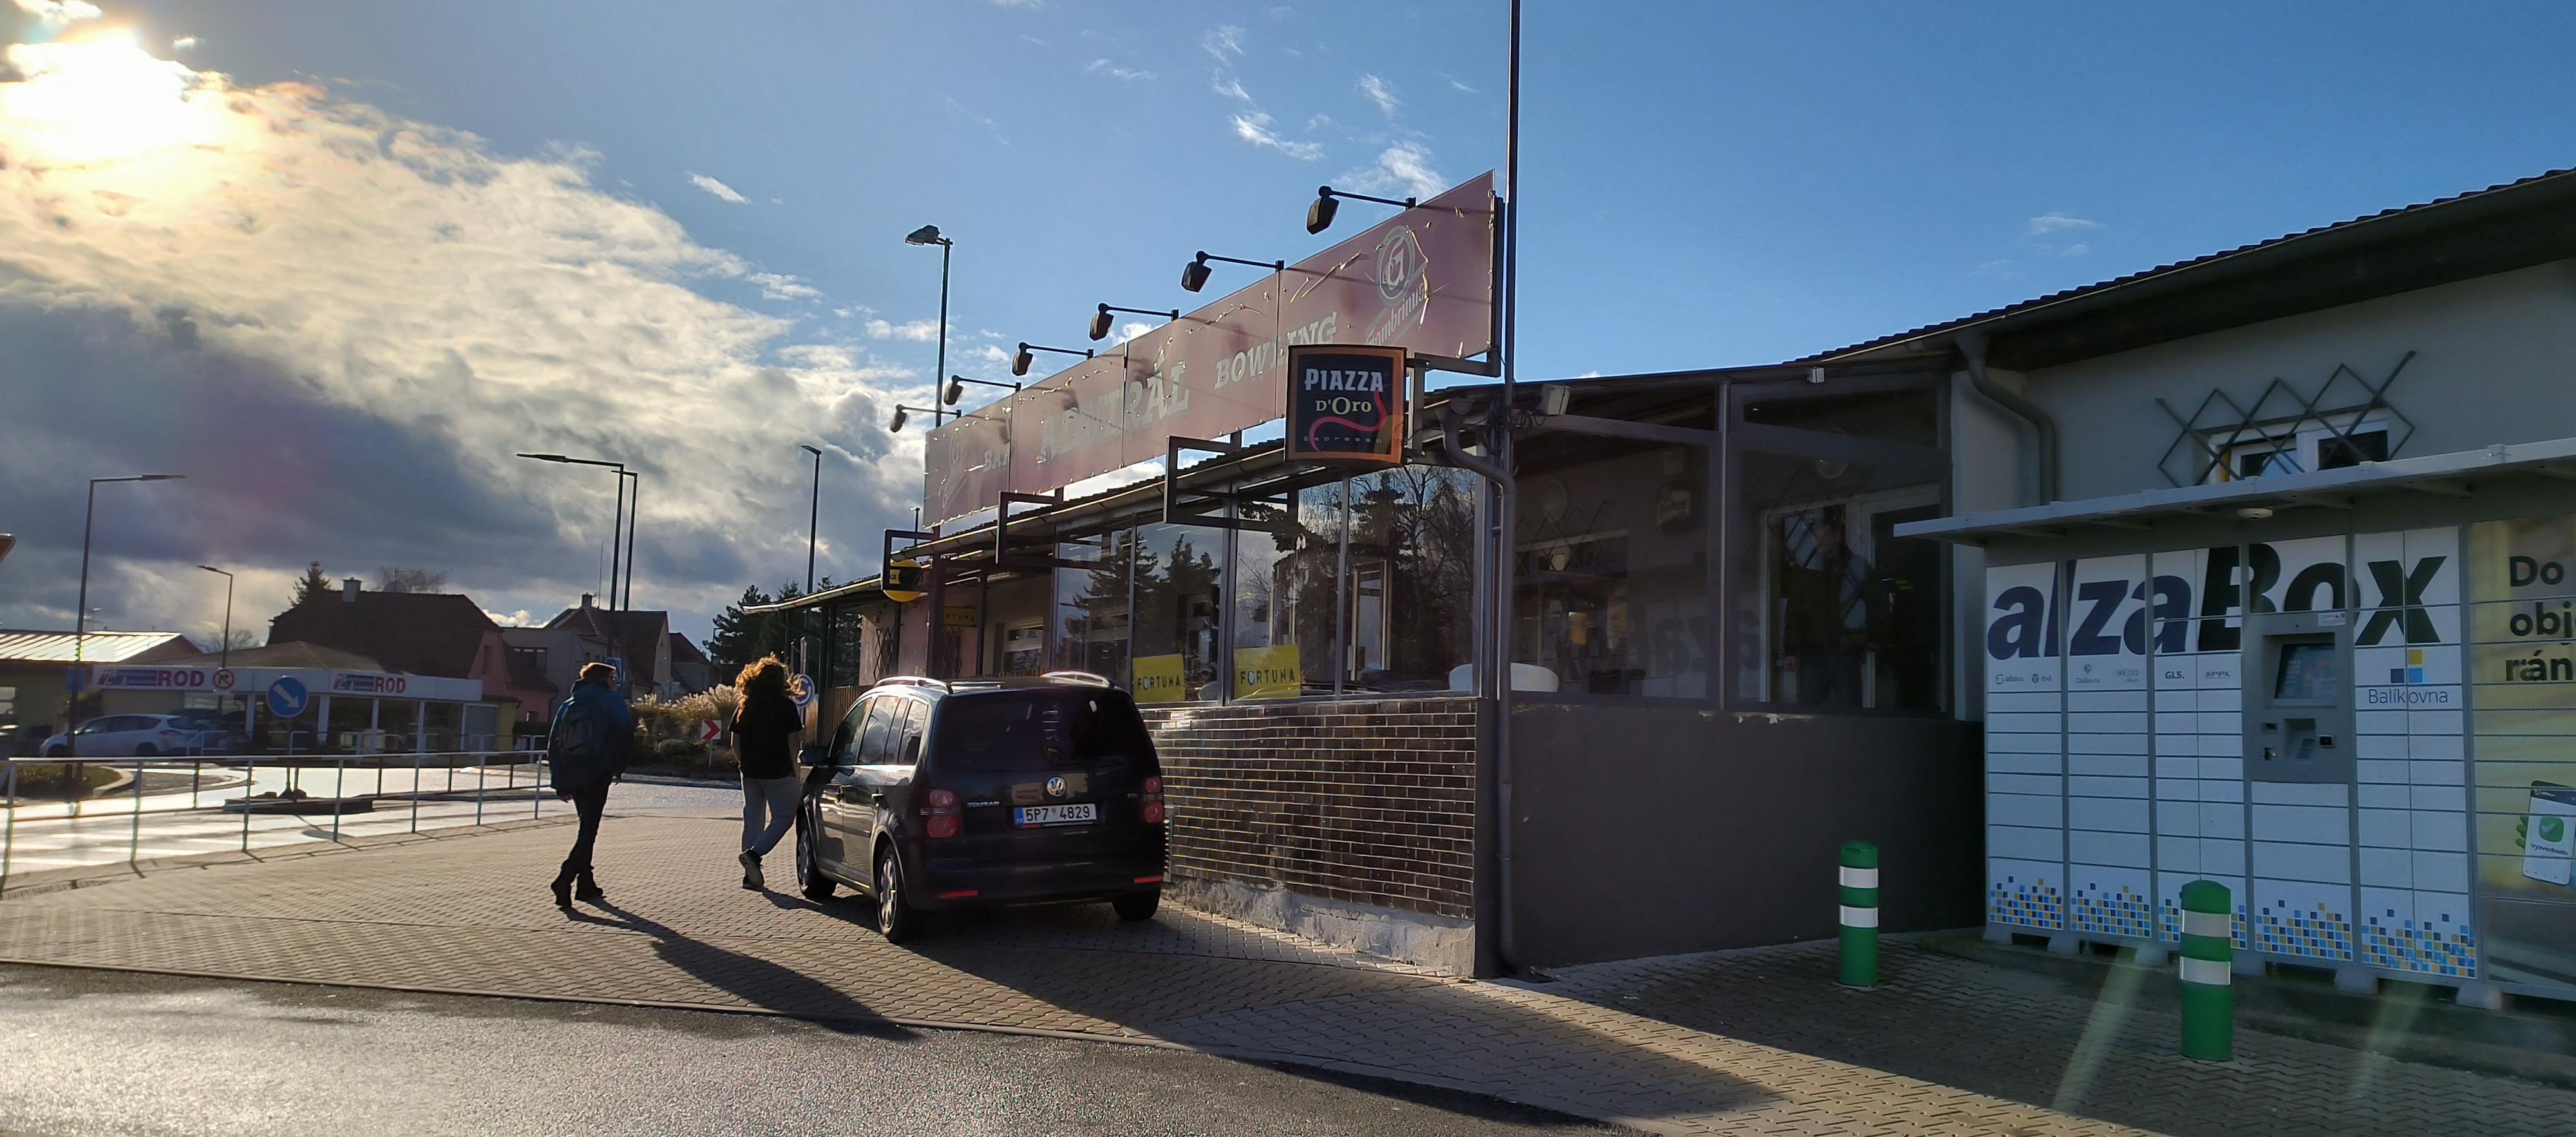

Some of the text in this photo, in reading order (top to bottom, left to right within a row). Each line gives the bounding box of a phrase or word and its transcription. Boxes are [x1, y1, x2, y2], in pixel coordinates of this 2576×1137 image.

[1304, 368, 1384, 392] PIAZZA
[1315, 396, 1372, 415] D'Oro
[1303, 435, 1383, 444] Espresso
[2509, 555, 2564, 588] Do
[1987, 542, 2448, 660] alzaBox
[2509, 600, 2576, 645] obj
[2505, 649, 2576, 682] rán
[156, 669, 205, 687] ROD
[374, 676, 406, 694] ROD
[1137, 676, 1181, 691] FORTUNA
[1240, 668, 1296, 685] FORTUNA
[2368, 688, 2448, 704] Balíkovna
[1025, 805, 1090, 822] 5P7 4829
